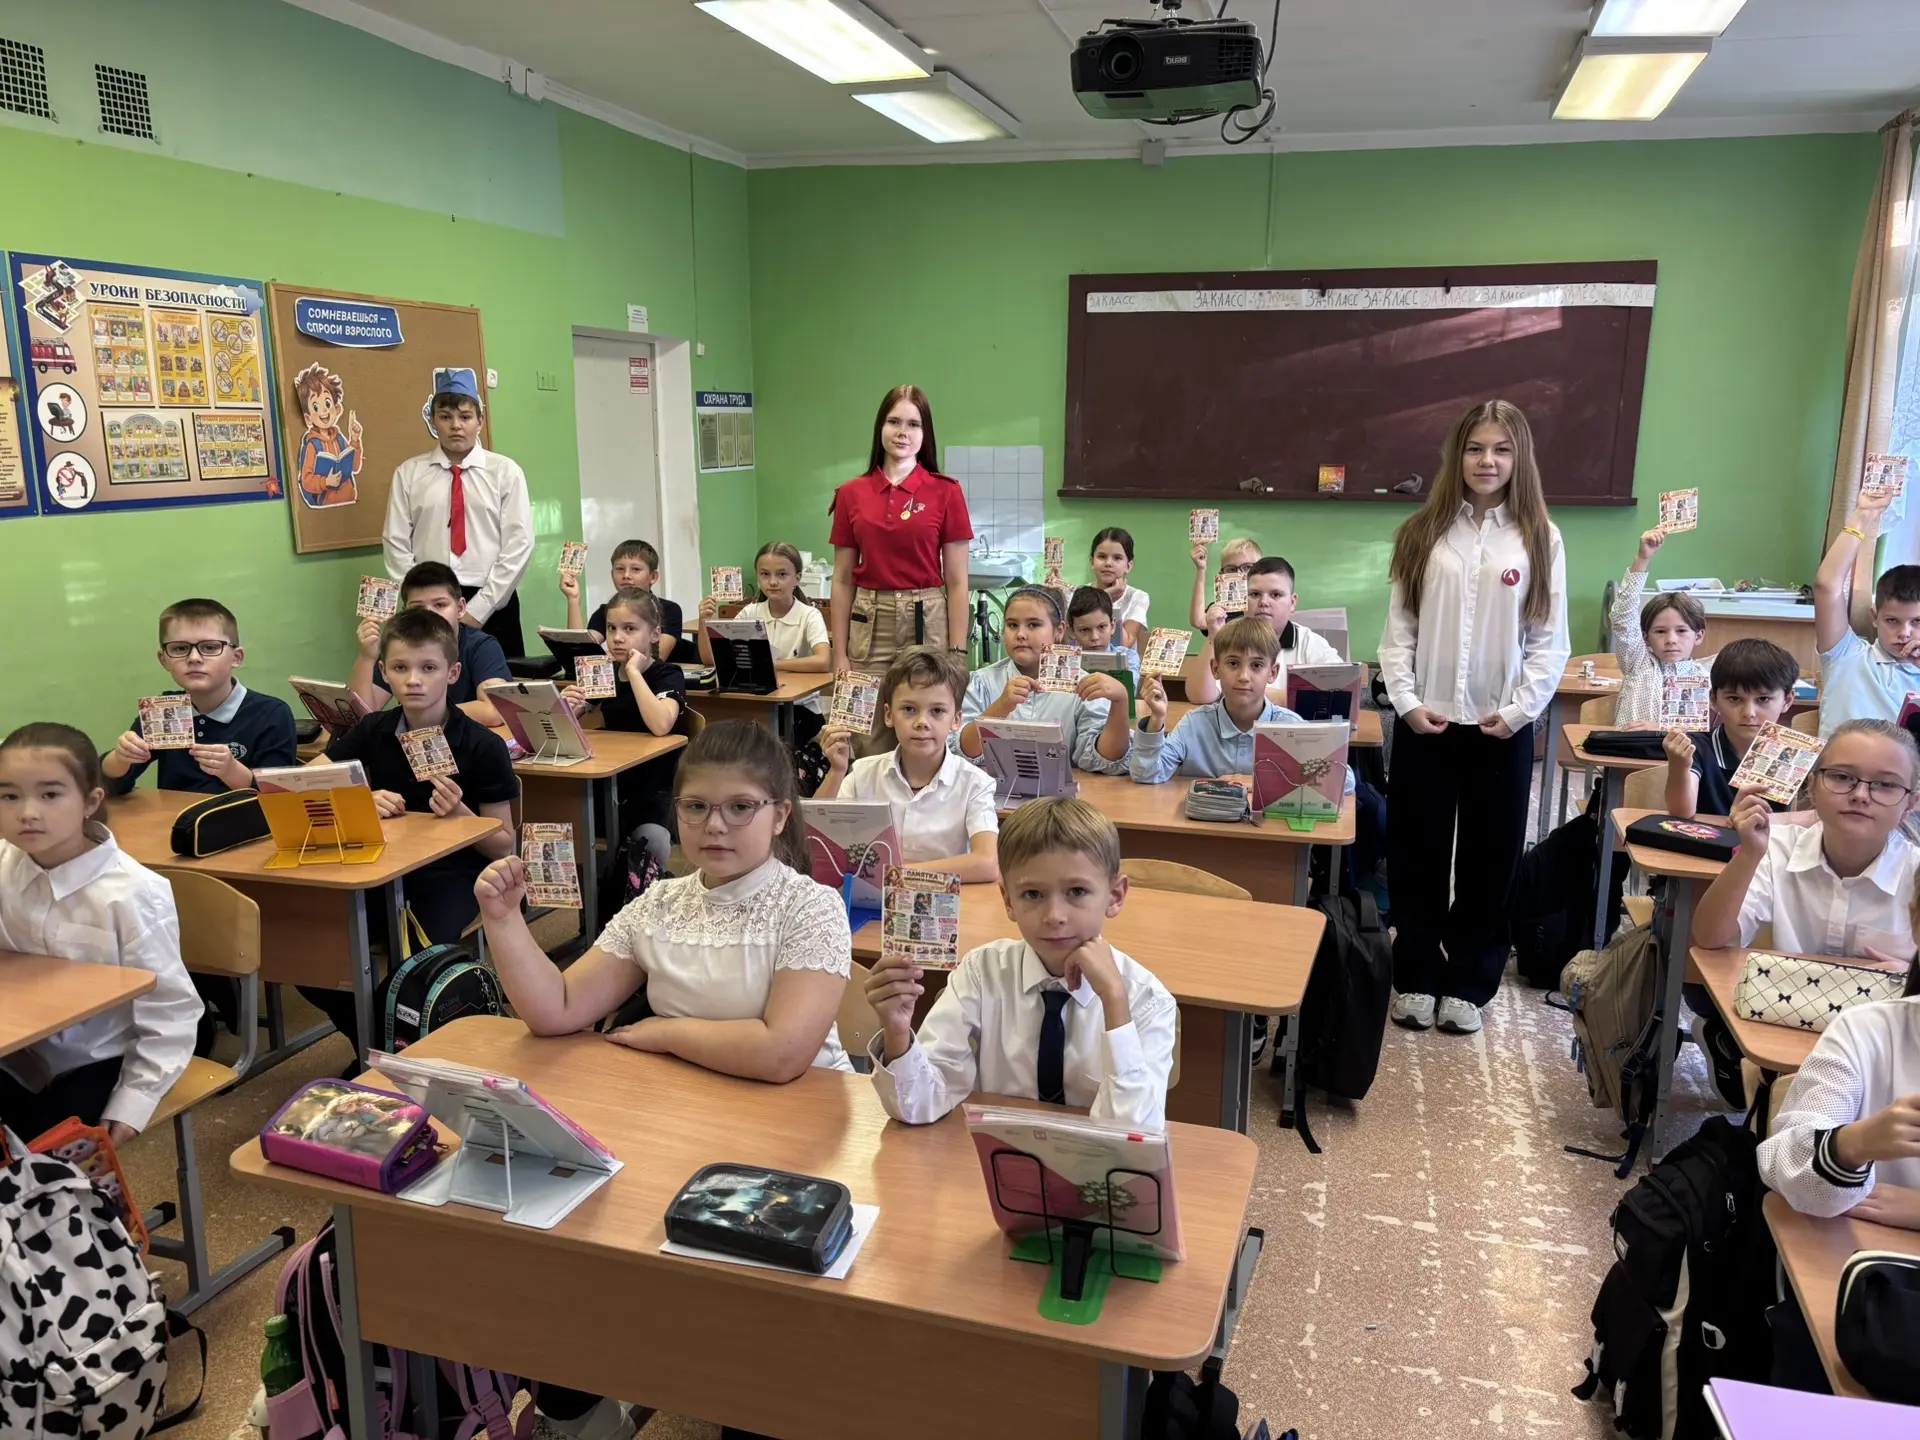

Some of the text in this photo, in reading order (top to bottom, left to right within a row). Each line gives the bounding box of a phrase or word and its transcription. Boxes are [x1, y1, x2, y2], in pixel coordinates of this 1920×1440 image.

[1165, 56, 1187, 64] BenQ
[89, 282, 246, 310] УРОКИ БЕЗОПАСНОСТИ
[308, 308, 378, 324] СОМНЕВАЕШЬСЯ
[306, 321, 392, 339] СПРОСИ ВЗРОСЛОГО
[703, 393, 747, 407] ОХРАНА ТРУДА
[906, 870, 938, 880] ПАМЯТКА
